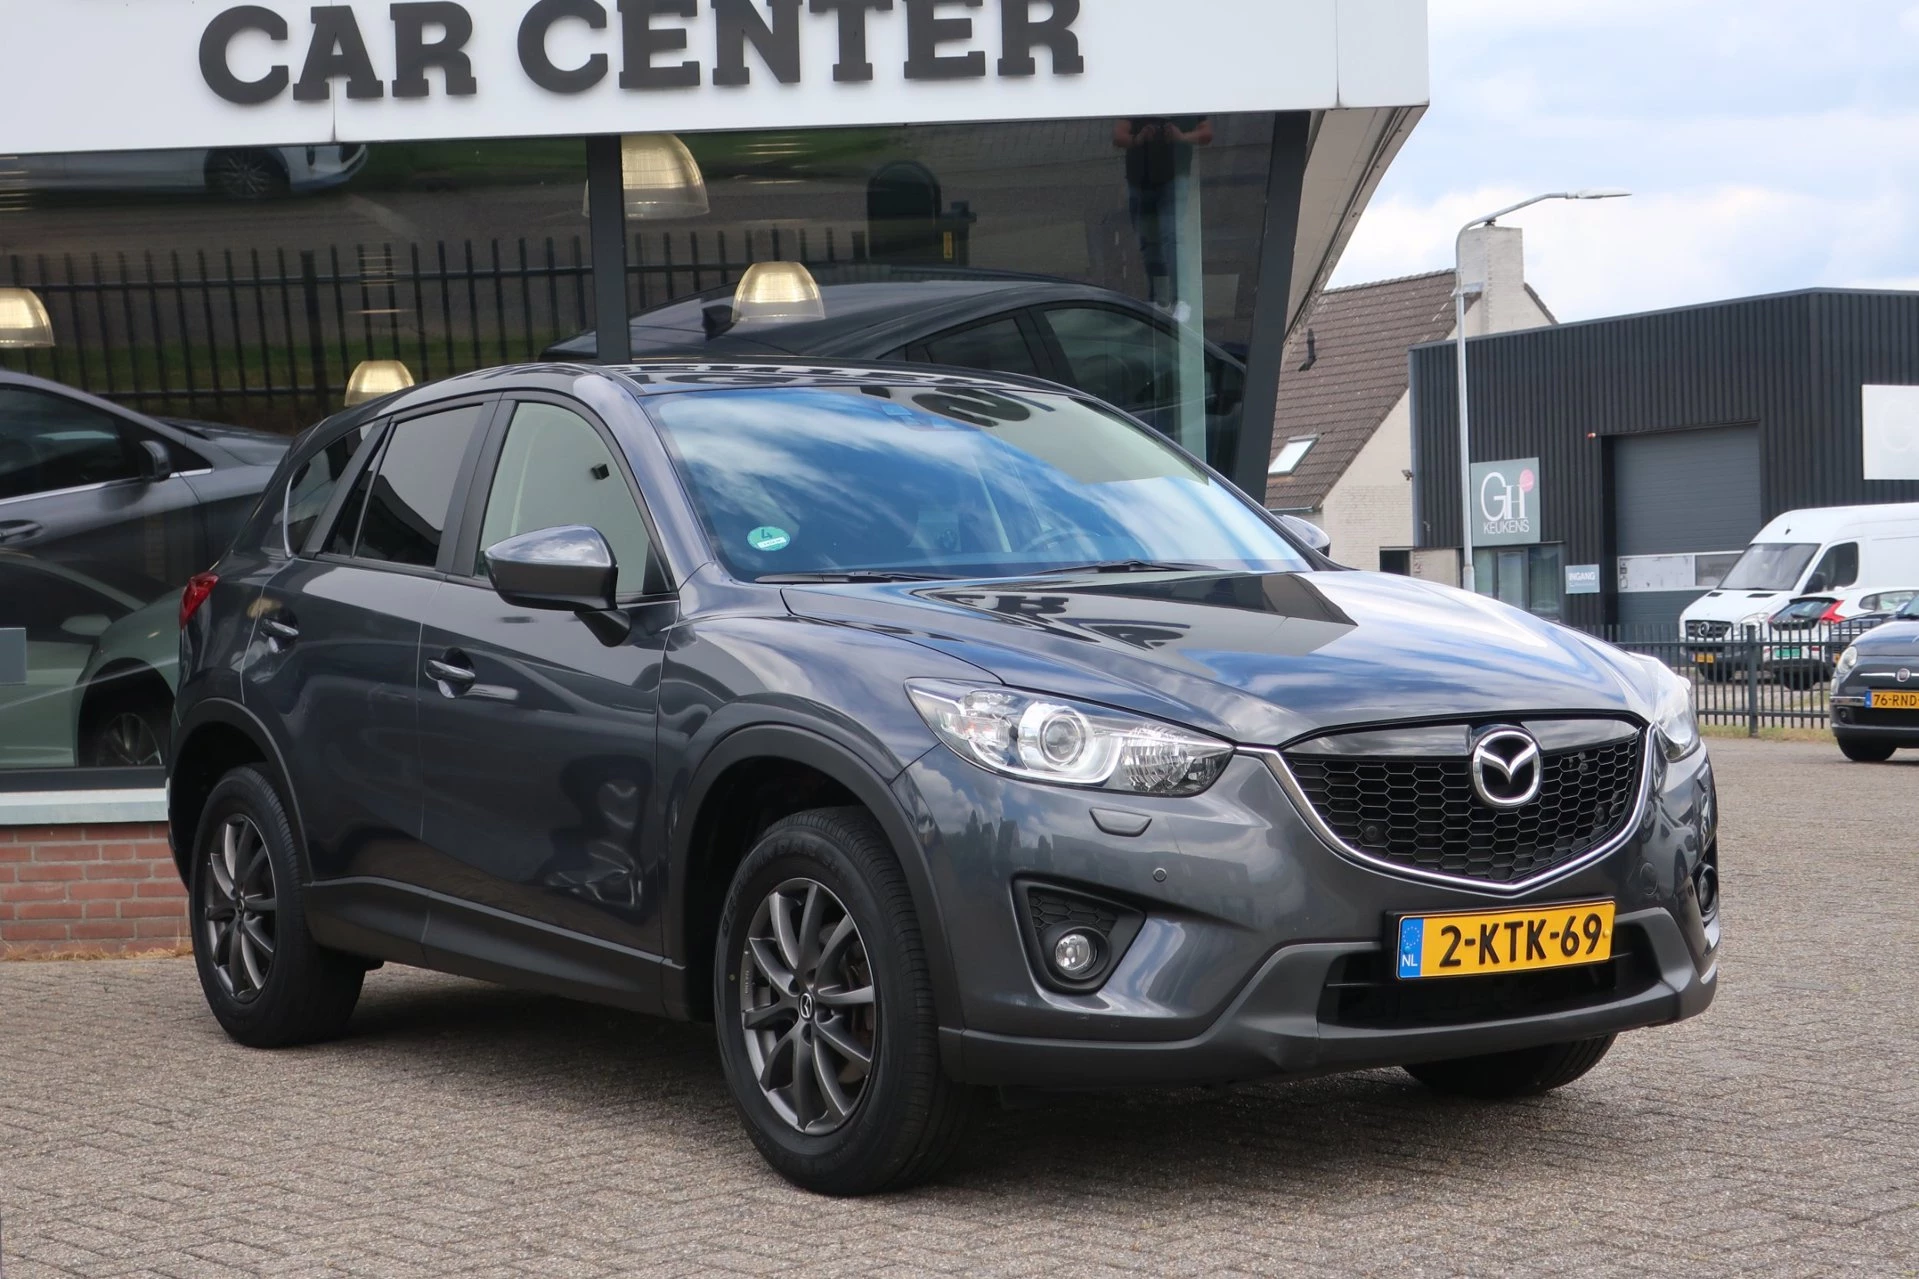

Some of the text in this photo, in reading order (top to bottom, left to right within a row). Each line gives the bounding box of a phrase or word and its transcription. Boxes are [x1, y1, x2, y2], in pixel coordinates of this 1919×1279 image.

[199, 0, 1084, 106] CAR CENTER
[1483, 519, 1530, 534] KEUKENS
[1438, 912, 1604, 968] 2-KTK-69
[1401, 953, 1418, 968] NL
